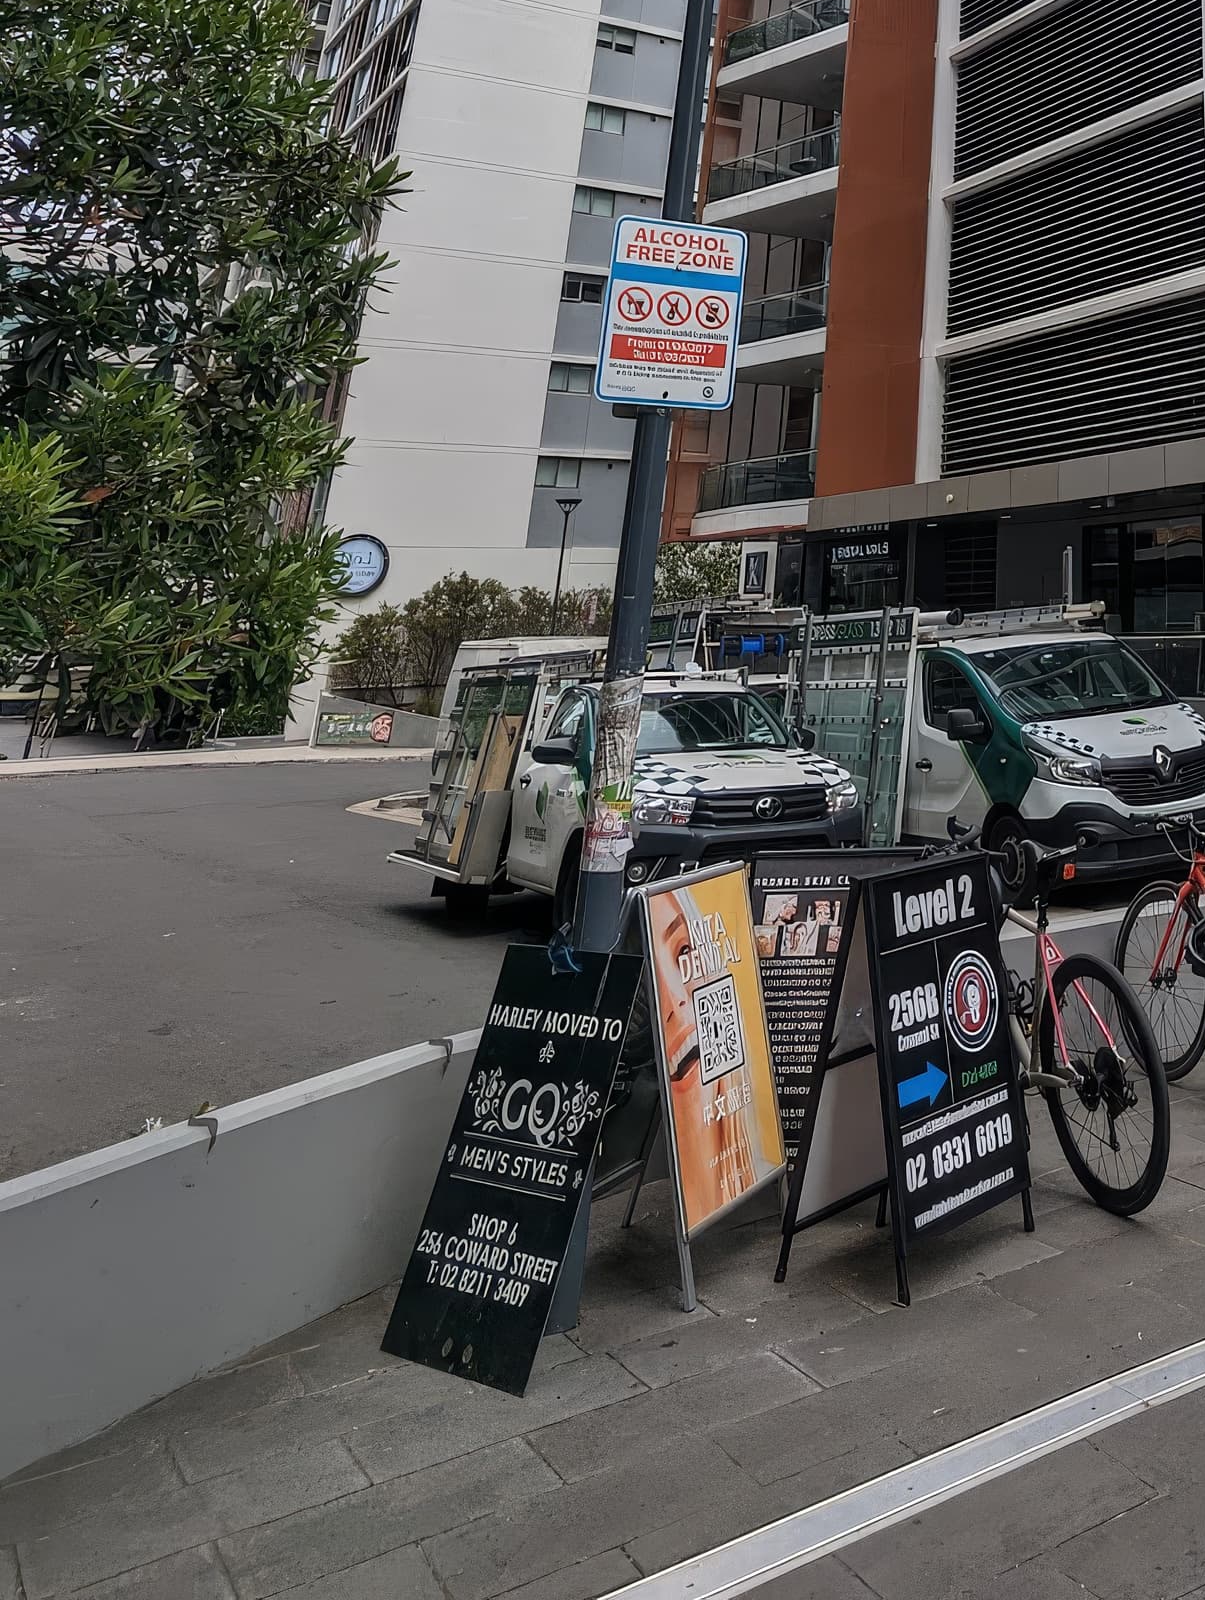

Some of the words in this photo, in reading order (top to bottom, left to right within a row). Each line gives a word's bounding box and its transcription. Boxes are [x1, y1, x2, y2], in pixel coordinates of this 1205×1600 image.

[626, 244, 675, 263] FREE
[679, 251, 734, 271] ZONE
[634, 228, 729, 253] ALCOHOL
[893, 878, 957, 938] Level
[957, 874, 975, 919] 2
[489, 1004, 543, 1030] HARLEY
[541, 1010, 599, 1038] MOVED
[601, 1018, 623, 1041] TO
[460, 1144, 510, 1174] MEN'S
[511, 1156, 568, 1186] STYLES
[905, 1153, 928, 1192] 02
[468, 1213, 508, 1242] SHOP
[507, 1222, 519, 1246] 6
[417, 1229, 444, 1255] 256
[444, 1236, 510, 1272] COWARD
[510, 1252, 559, 1286] STREET
[440, 1263, 459, 1289] 02
[458, 1268, 492, 1298] 8211
[493, 1277, 531, 1307] 3409
